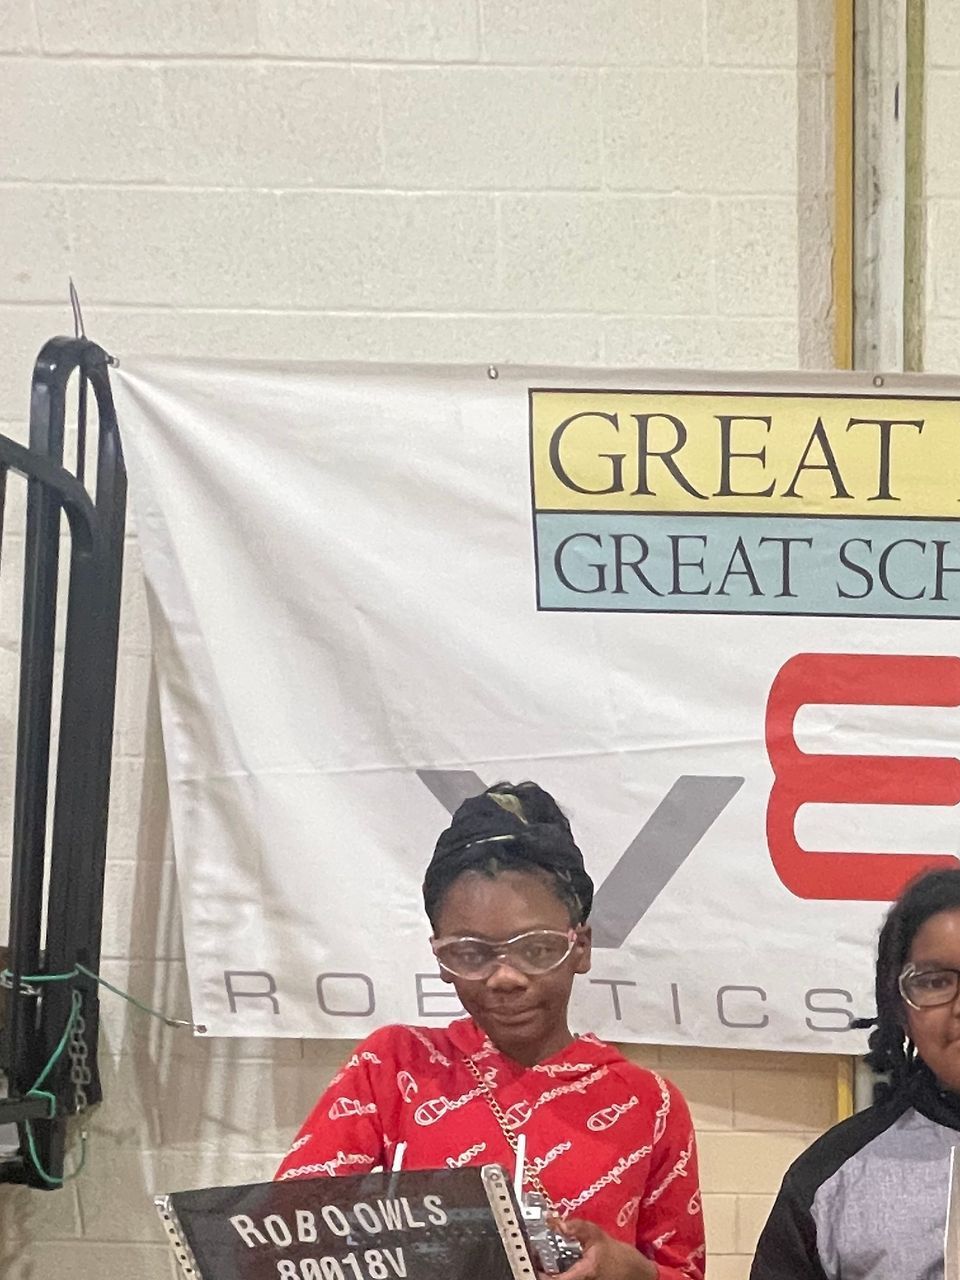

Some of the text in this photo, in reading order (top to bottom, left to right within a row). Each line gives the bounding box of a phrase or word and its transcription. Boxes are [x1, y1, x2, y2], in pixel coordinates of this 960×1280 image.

[548, 411, 924, 500] GREAT
[553, 532, 813, 599] GREAT
[224, 970, 854, 1033] ROBTICS
